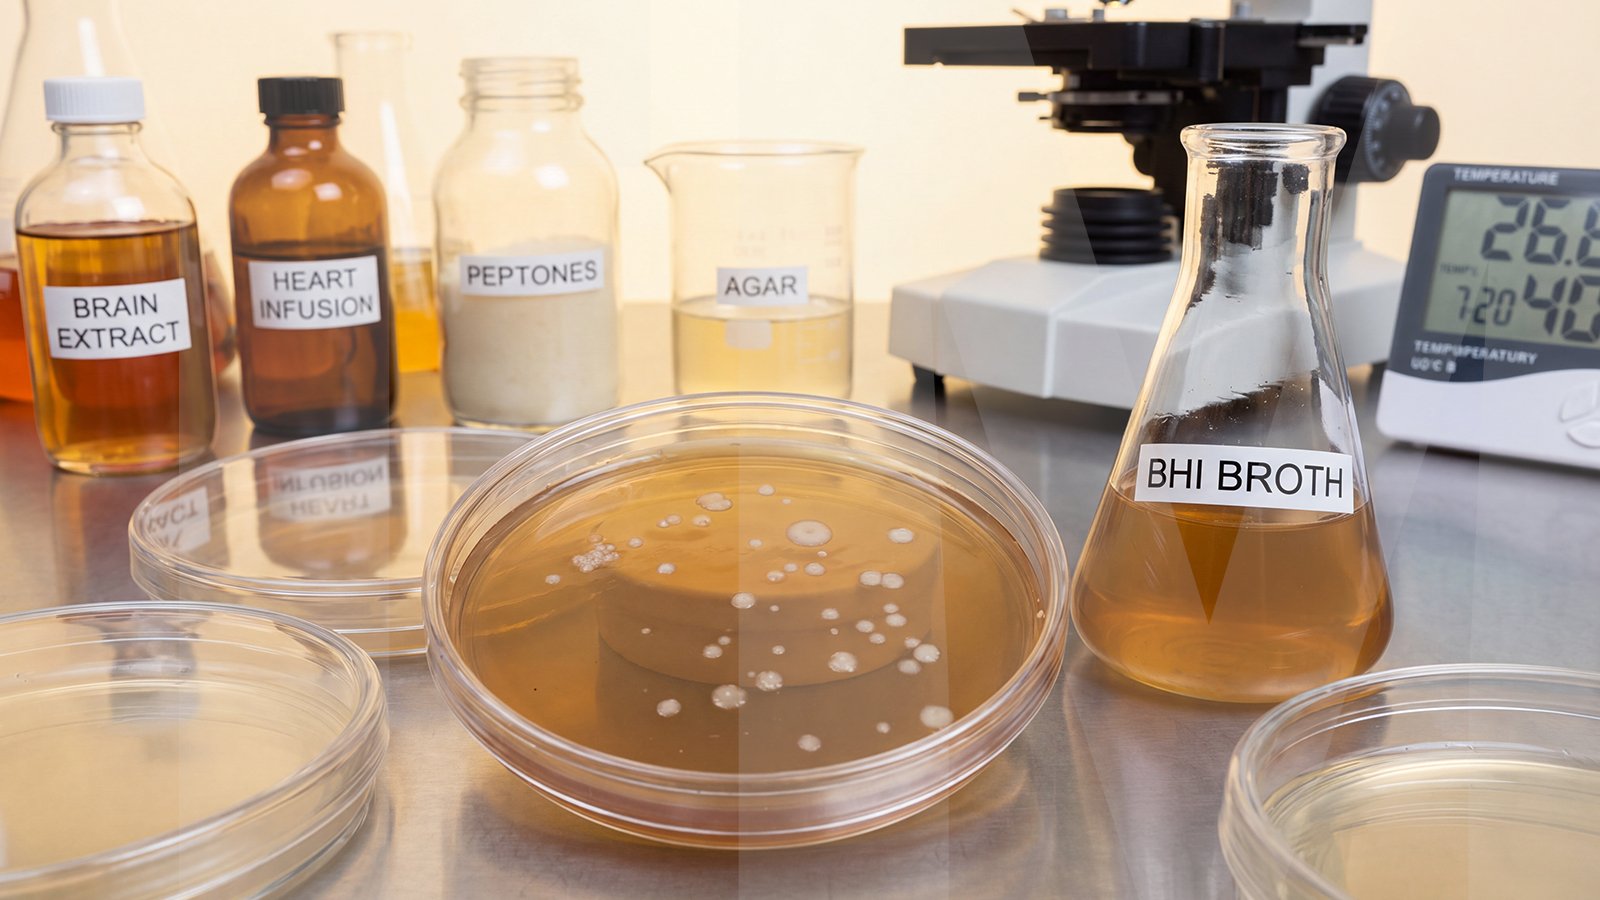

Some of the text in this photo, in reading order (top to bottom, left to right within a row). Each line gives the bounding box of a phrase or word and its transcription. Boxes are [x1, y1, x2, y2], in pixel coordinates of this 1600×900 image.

[1454, 166, 1560, 186] TEMPERATURE
[273, 268, 358, 292] HEART
[467, 260, 598, 287] PEPTONES
[724, 275, 798, 298] AGAR
[73, 294, 159, 319] BRAIN
[259, 295, 374, 320] INFUSION
[57, 320, 180, 350] EXTRACT
[1147, 458, 1343, 499] BHI BROTH
